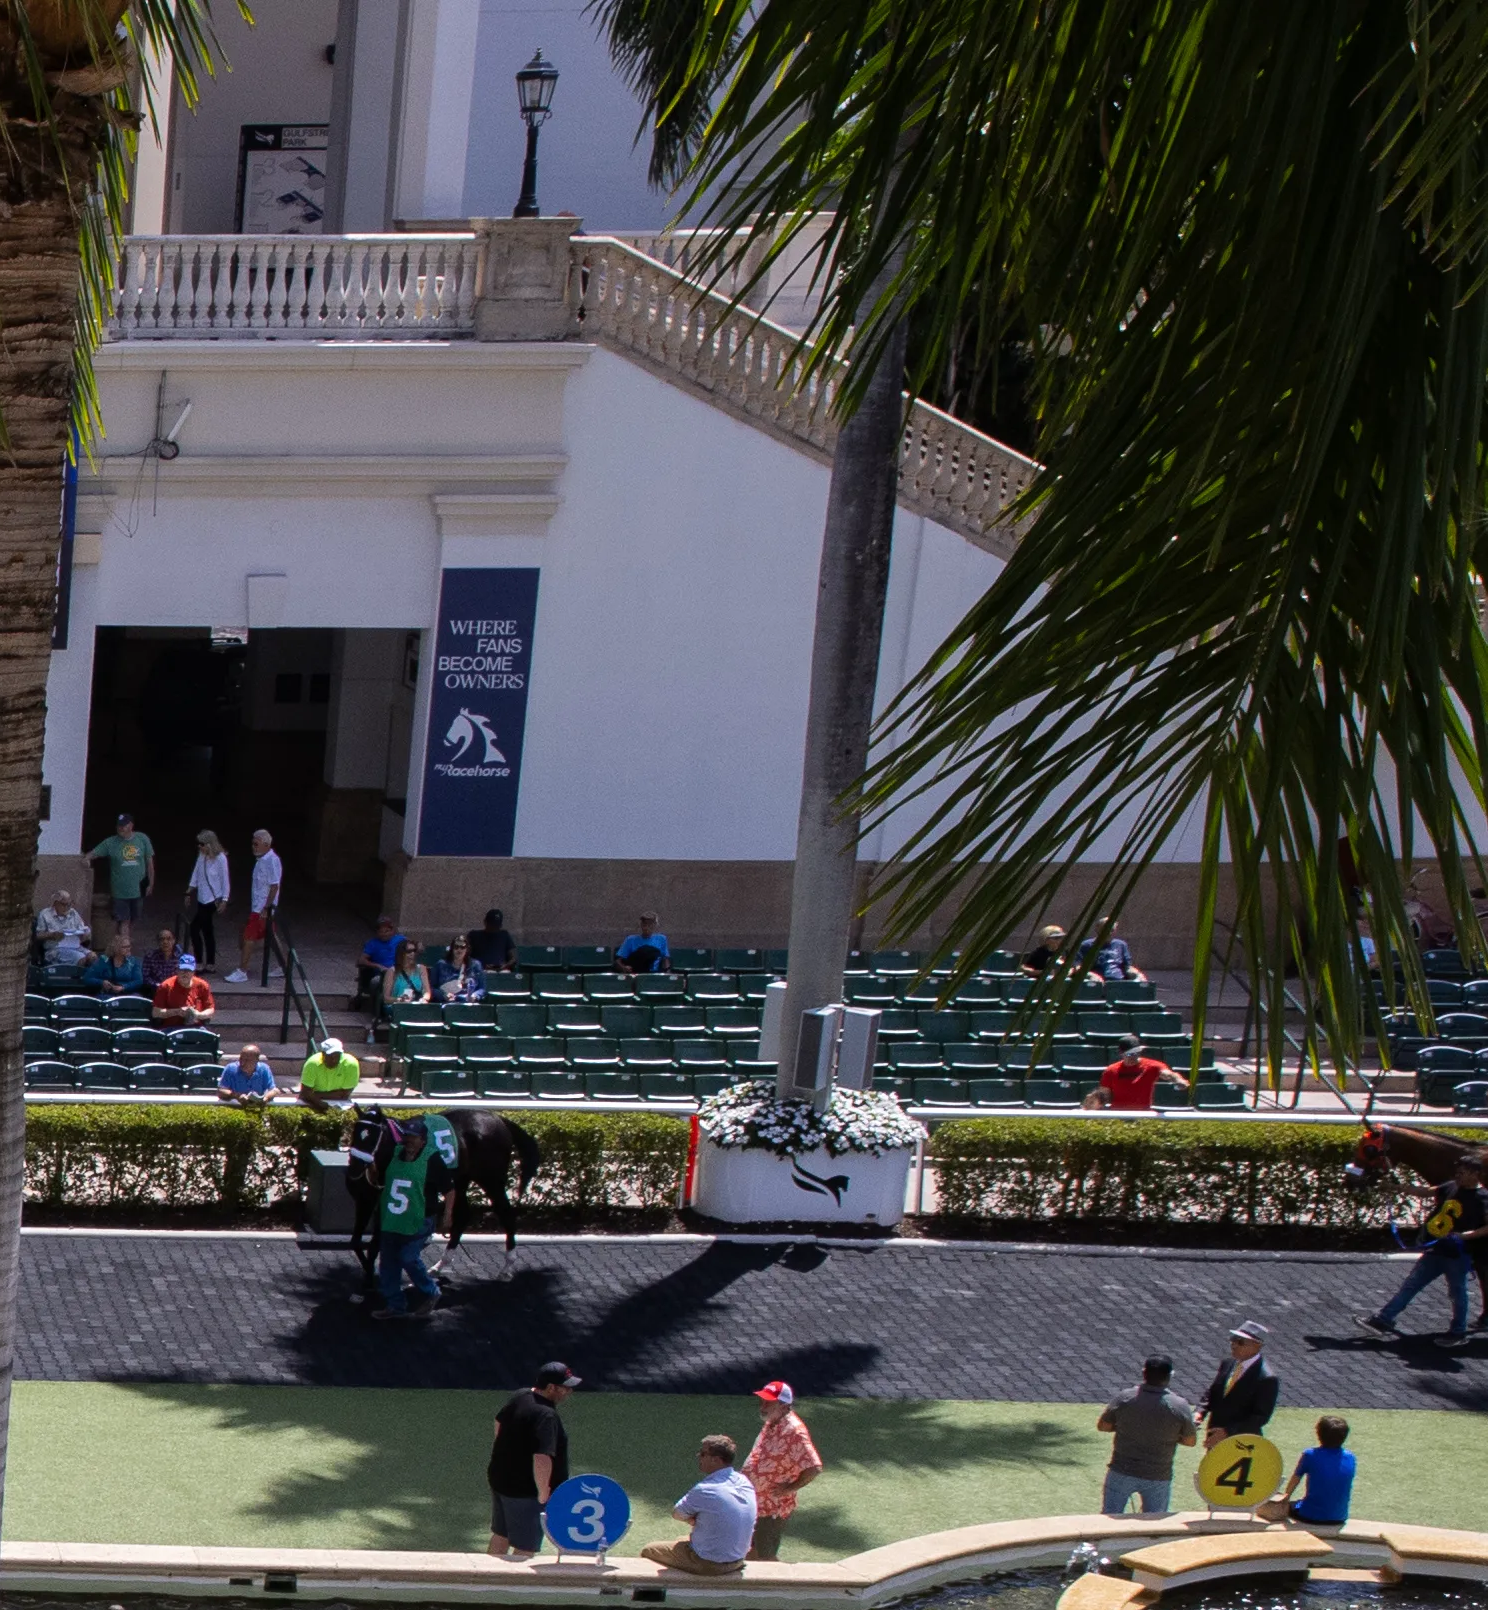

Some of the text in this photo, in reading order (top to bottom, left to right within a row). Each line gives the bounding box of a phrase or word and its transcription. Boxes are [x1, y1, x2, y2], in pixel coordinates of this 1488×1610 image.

[449, 620, 517, 635] WHERE
[438, 656, 513, 671] BECOME
[477, 638, 522, 654] FANS
[444, 673, 524, 689] OWNERS
[433, 1129, 456, 1164] 5
[387, 1178, 412, 1214] 5
[1427, 1199, 1463, 1238] 6
[1215, 1457, 1253, 1495] 4
[568, 1499, 605, 1543] 3
